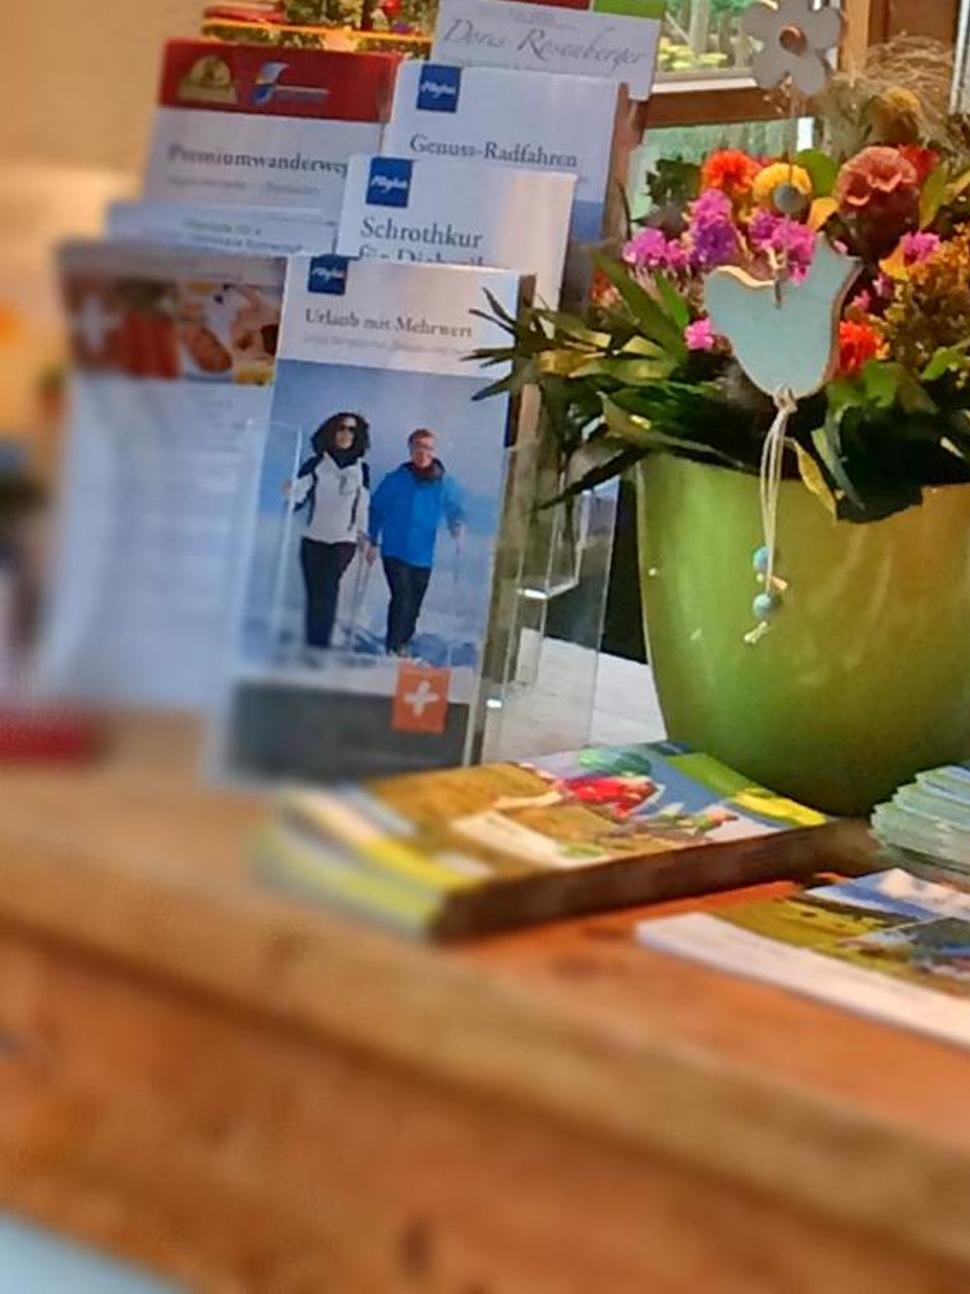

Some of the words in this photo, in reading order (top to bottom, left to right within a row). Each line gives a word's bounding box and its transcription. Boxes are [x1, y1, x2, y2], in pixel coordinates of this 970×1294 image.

[409, 133, 578, 168] Genuss-Radfahren
[360, 216, 483, 249] Schrothkur
[305, 308, 360, 327] Urlaub
[394, 316, 473, 338] Mehrwert
